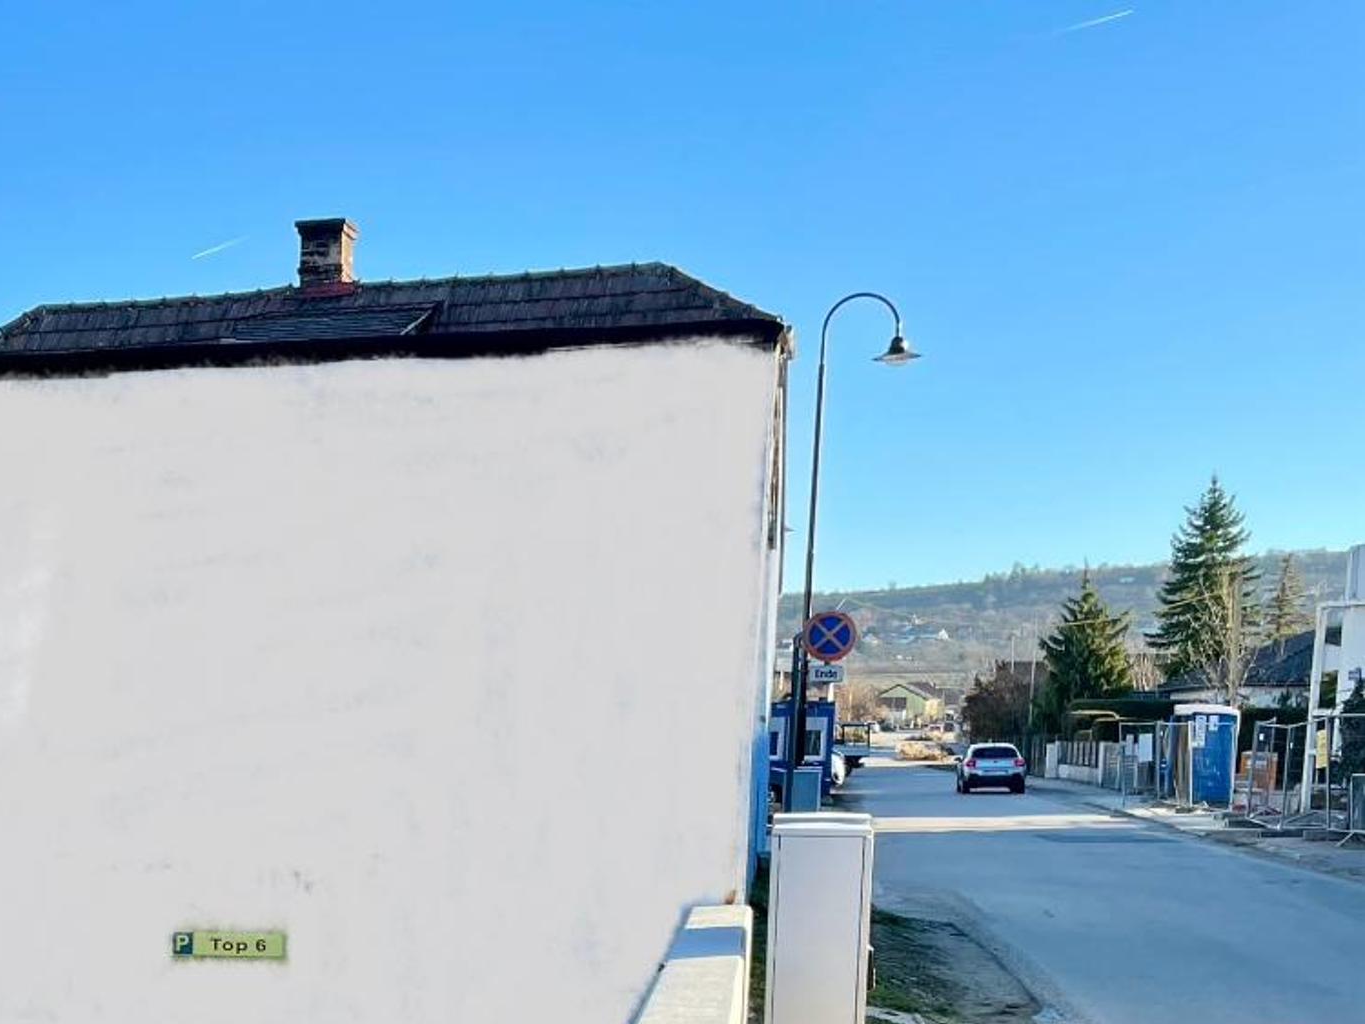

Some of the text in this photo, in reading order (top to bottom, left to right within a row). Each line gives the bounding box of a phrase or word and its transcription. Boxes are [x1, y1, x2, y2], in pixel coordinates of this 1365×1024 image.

[814, 668, 838, 679] Ende
[176, 935, 267, 954] P Top 6
